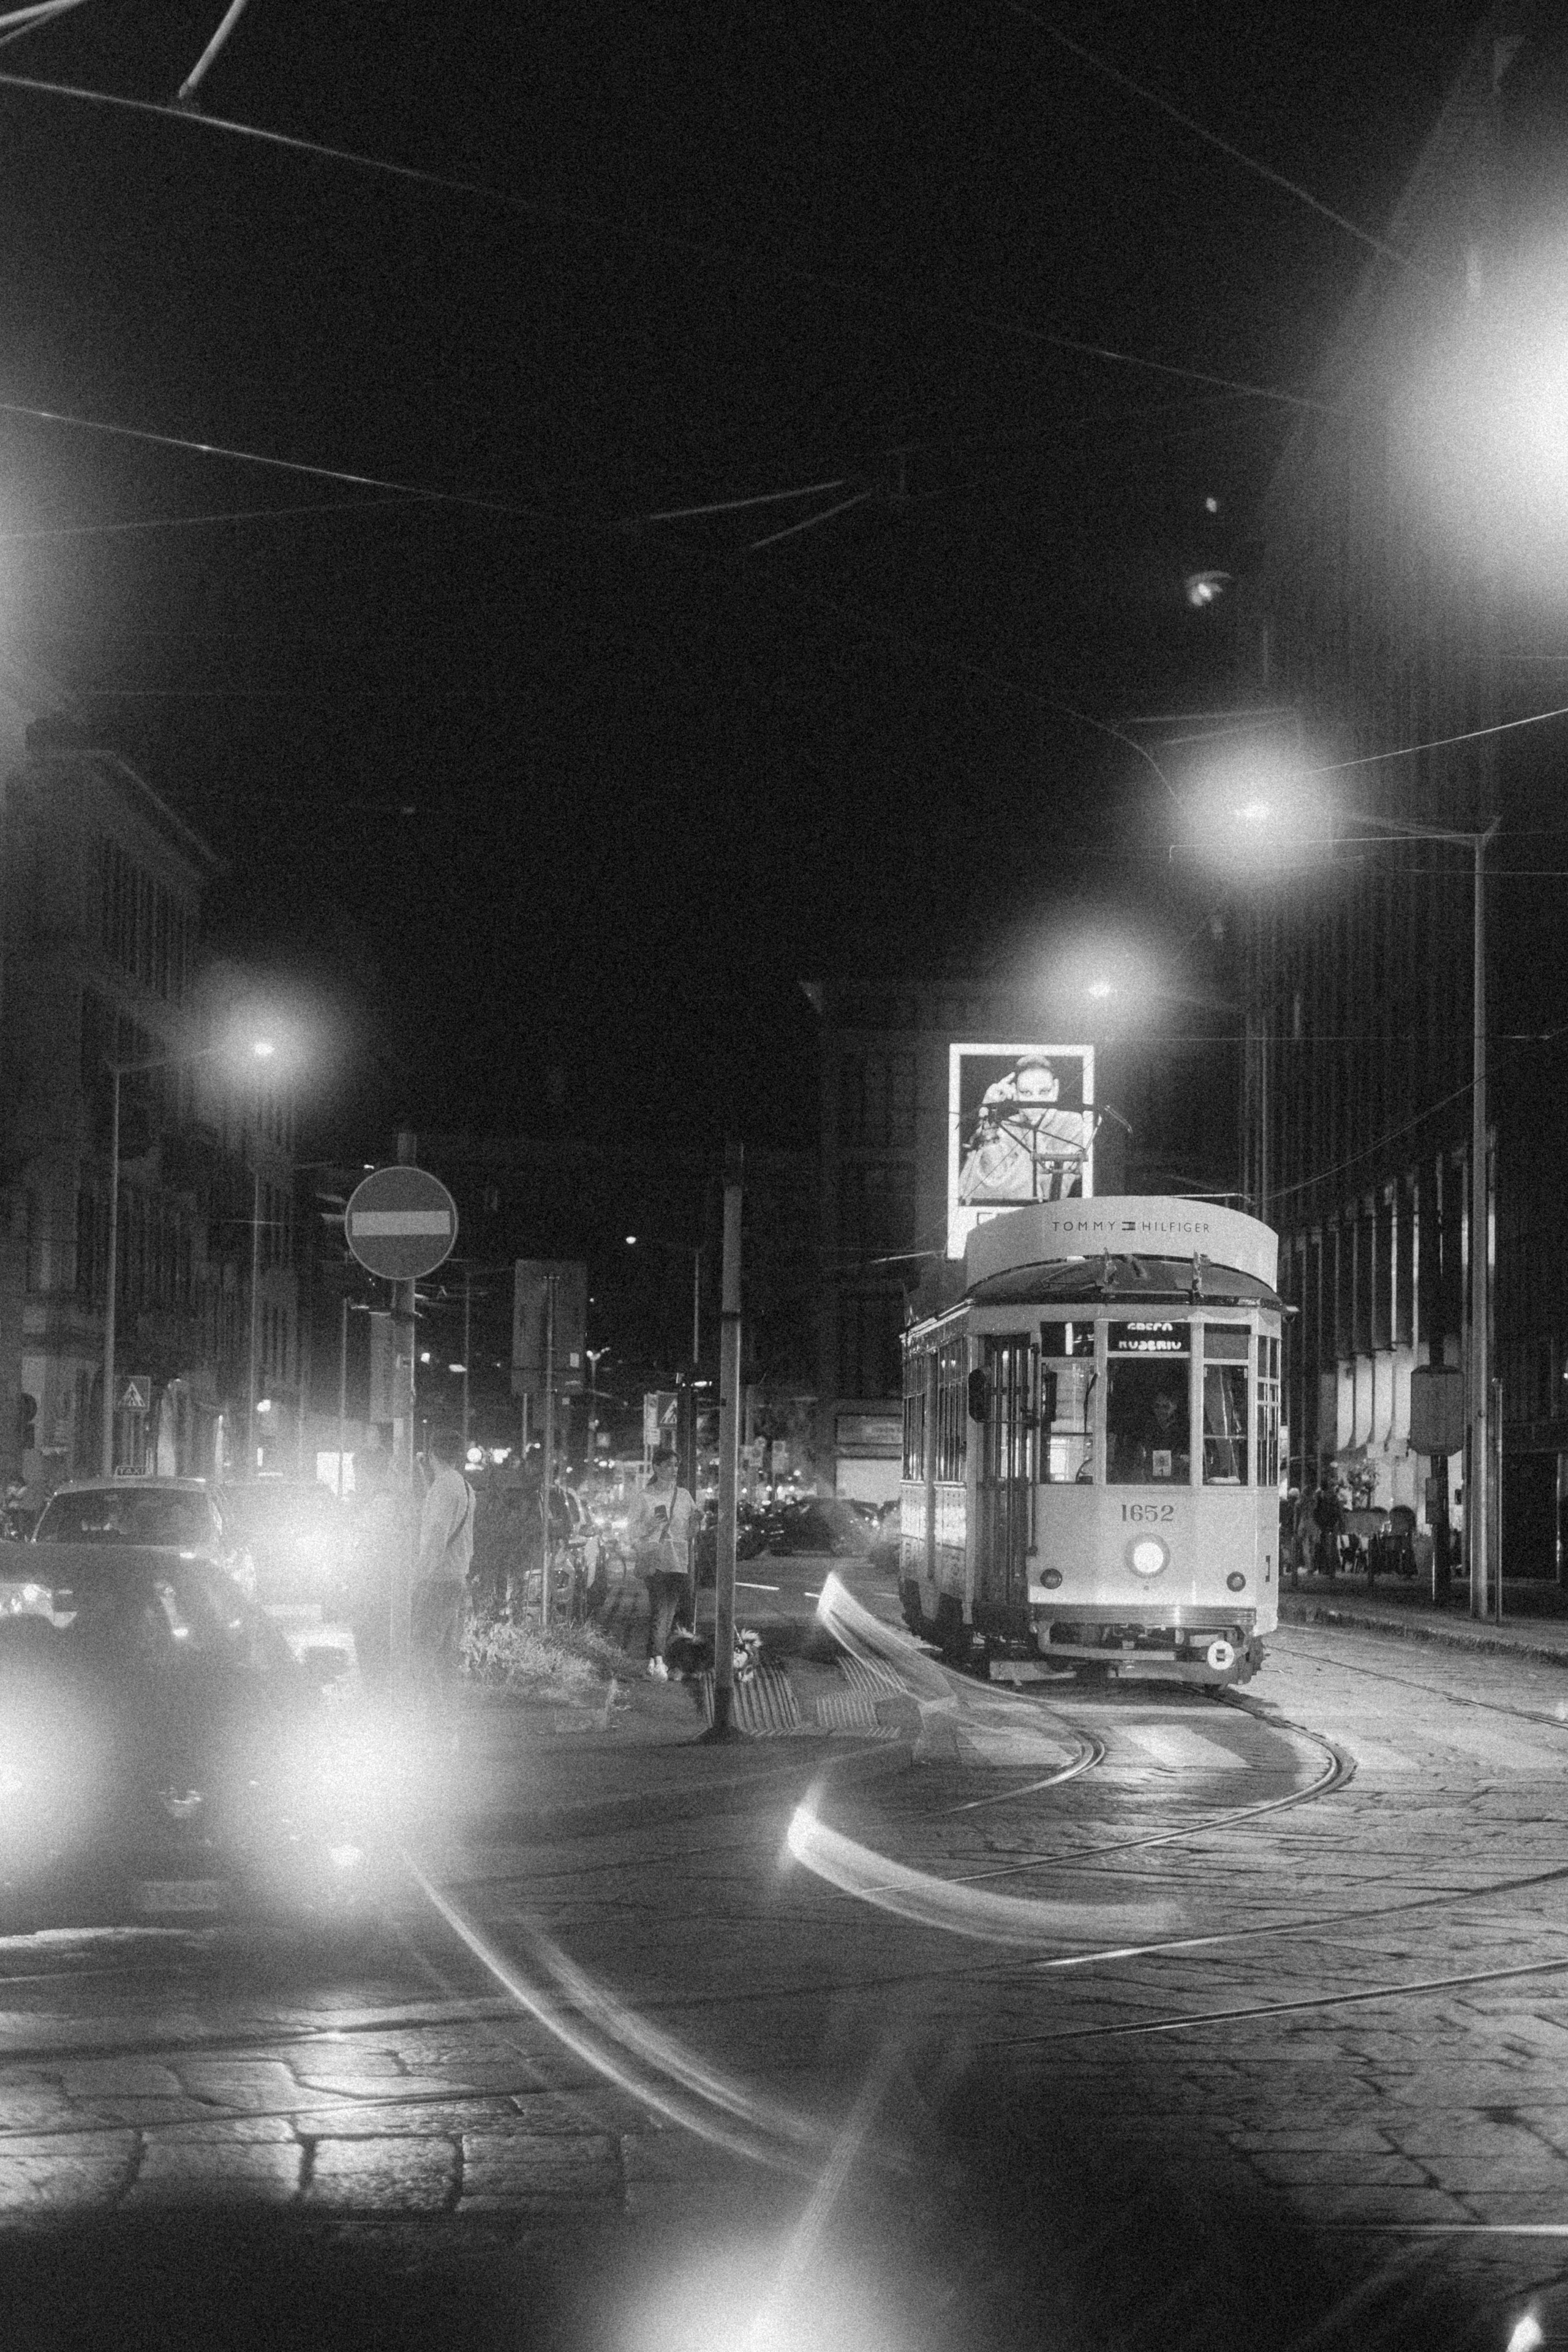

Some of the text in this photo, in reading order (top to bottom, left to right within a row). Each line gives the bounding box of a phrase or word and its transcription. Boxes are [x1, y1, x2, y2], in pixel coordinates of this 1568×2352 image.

[1052, 1221, 1210, 1233] TOMMY HILFIGER
[119, 1467, 145, 1476] TAXI
[1121, 1504, 1174, 1522] 1652
